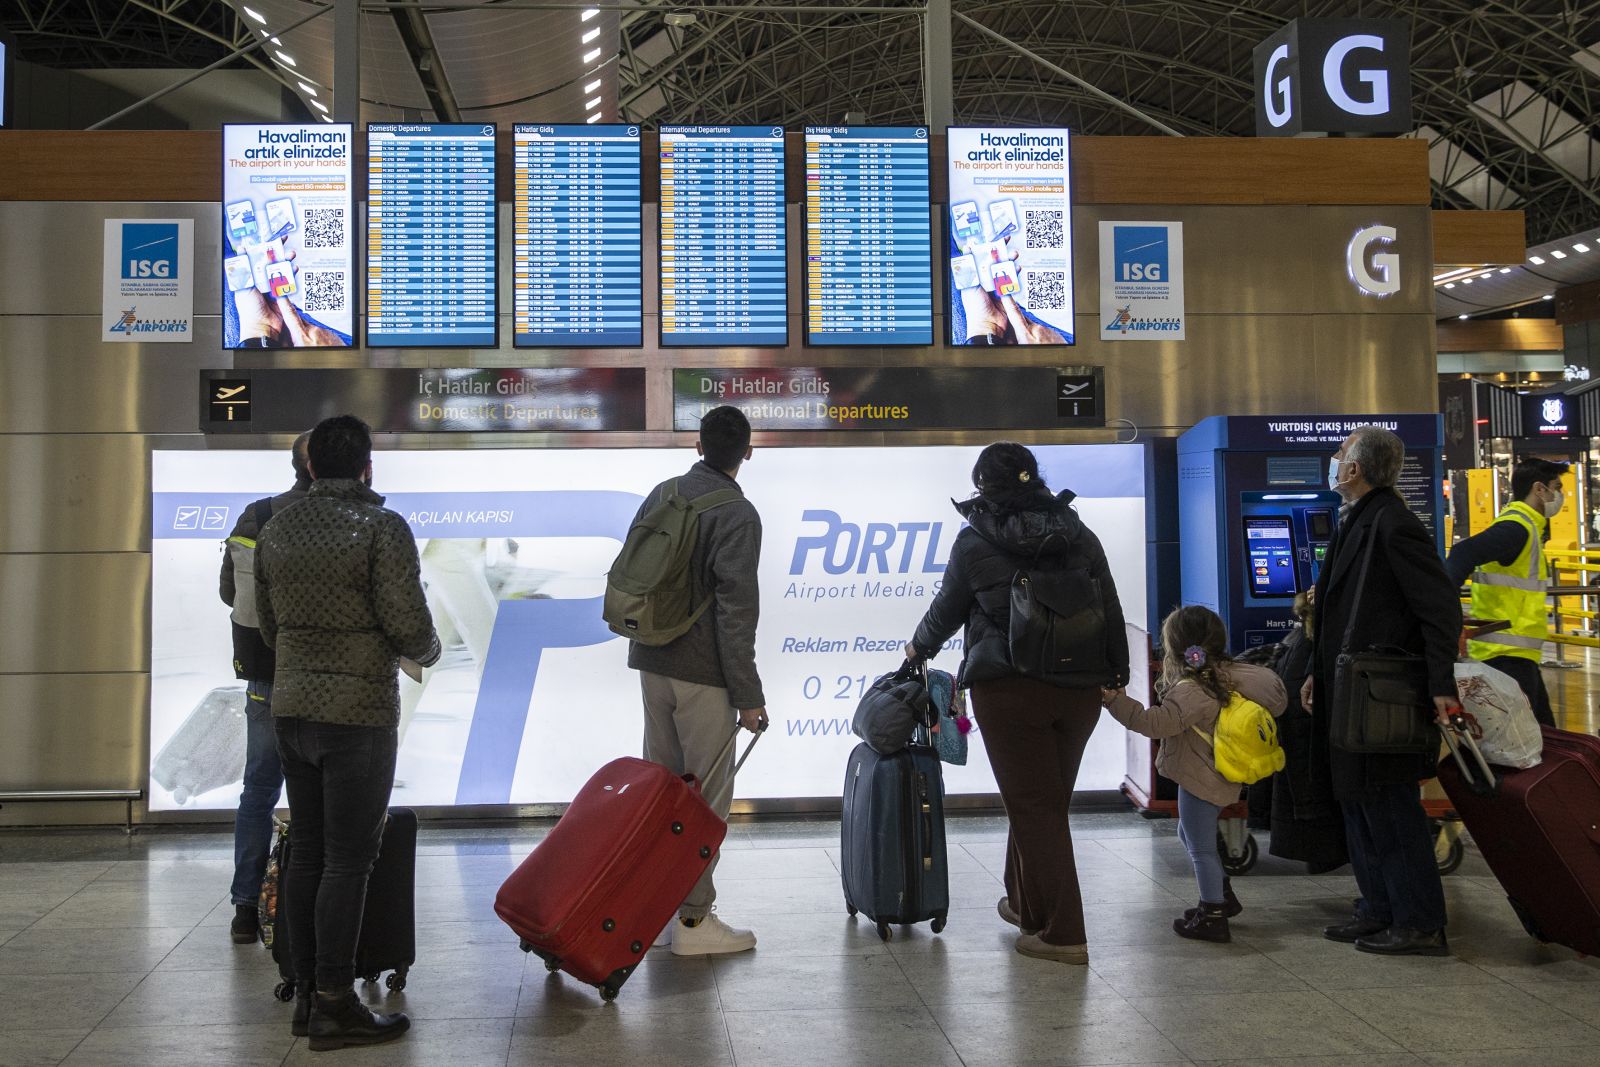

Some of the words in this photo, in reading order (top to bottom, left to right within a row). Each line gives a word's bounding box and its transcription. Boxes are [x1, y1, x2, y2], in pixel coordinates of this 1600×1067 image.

[1322, 34, 1390, 116] G
[1264, 45, 1292, 128] G
[258, 128, 346, 144] Havalimanı
[980, 132, 1063, 146] Havalimanı
[244, 145, 280, 158] artık
[284, 144, 346, 158] elinizde!
[968, 148, 1000, 161] artık
[1005, 148, 1064, 161] elinizde!
[230, 159, 247, 168] The
[250, 159, 280, 169] airport
[284, 159, 292, 167] in
[294, 160, 314, 169] your
[316, 159, 346, 167] hands
[954, 161, 970, 169] The
[973, 161, 1002, 171] airport
[1015, 162, 1034, 171] your
[1036, 162, 1064, 170] hands
[1348, 225, 1400, 294] G
[130, 260, 169, 277] ISG
[1123, 263, 1160, 280] ISG
[132, 323, 187, 332] AIRPORTS
[419, 374, 432, 398] İç
[438, 378, 491, 394] Hatlar
[496, 378, 538, 399] Gidiş
[701, 378, 726, 398] Dış
[732, 377, 783, 394] Hatlar
[789, 377, 830, 398] Gidiş
[419, 402, 497, 419] Domestic
[504, 404, 598, 422] Departures
[816, 402, 909, 422] Departures
[1268, 422, 1312, 433] YURTDIŞI
[1316, 422, 1341, 433] ÇIKIŞ
[407, 511, 462, 526] AÇILAN
[466, 510, 514, 523] KAPISI
[789, 510, 968, 575] PORTL
[784, 582, 856, 602] Airport
[863, 581, 924, 597] Media
[1266, 620, 1286, 628] Harç
[782, 637, 848, 653] Reklam
[803, 675, 822, 700] 0
